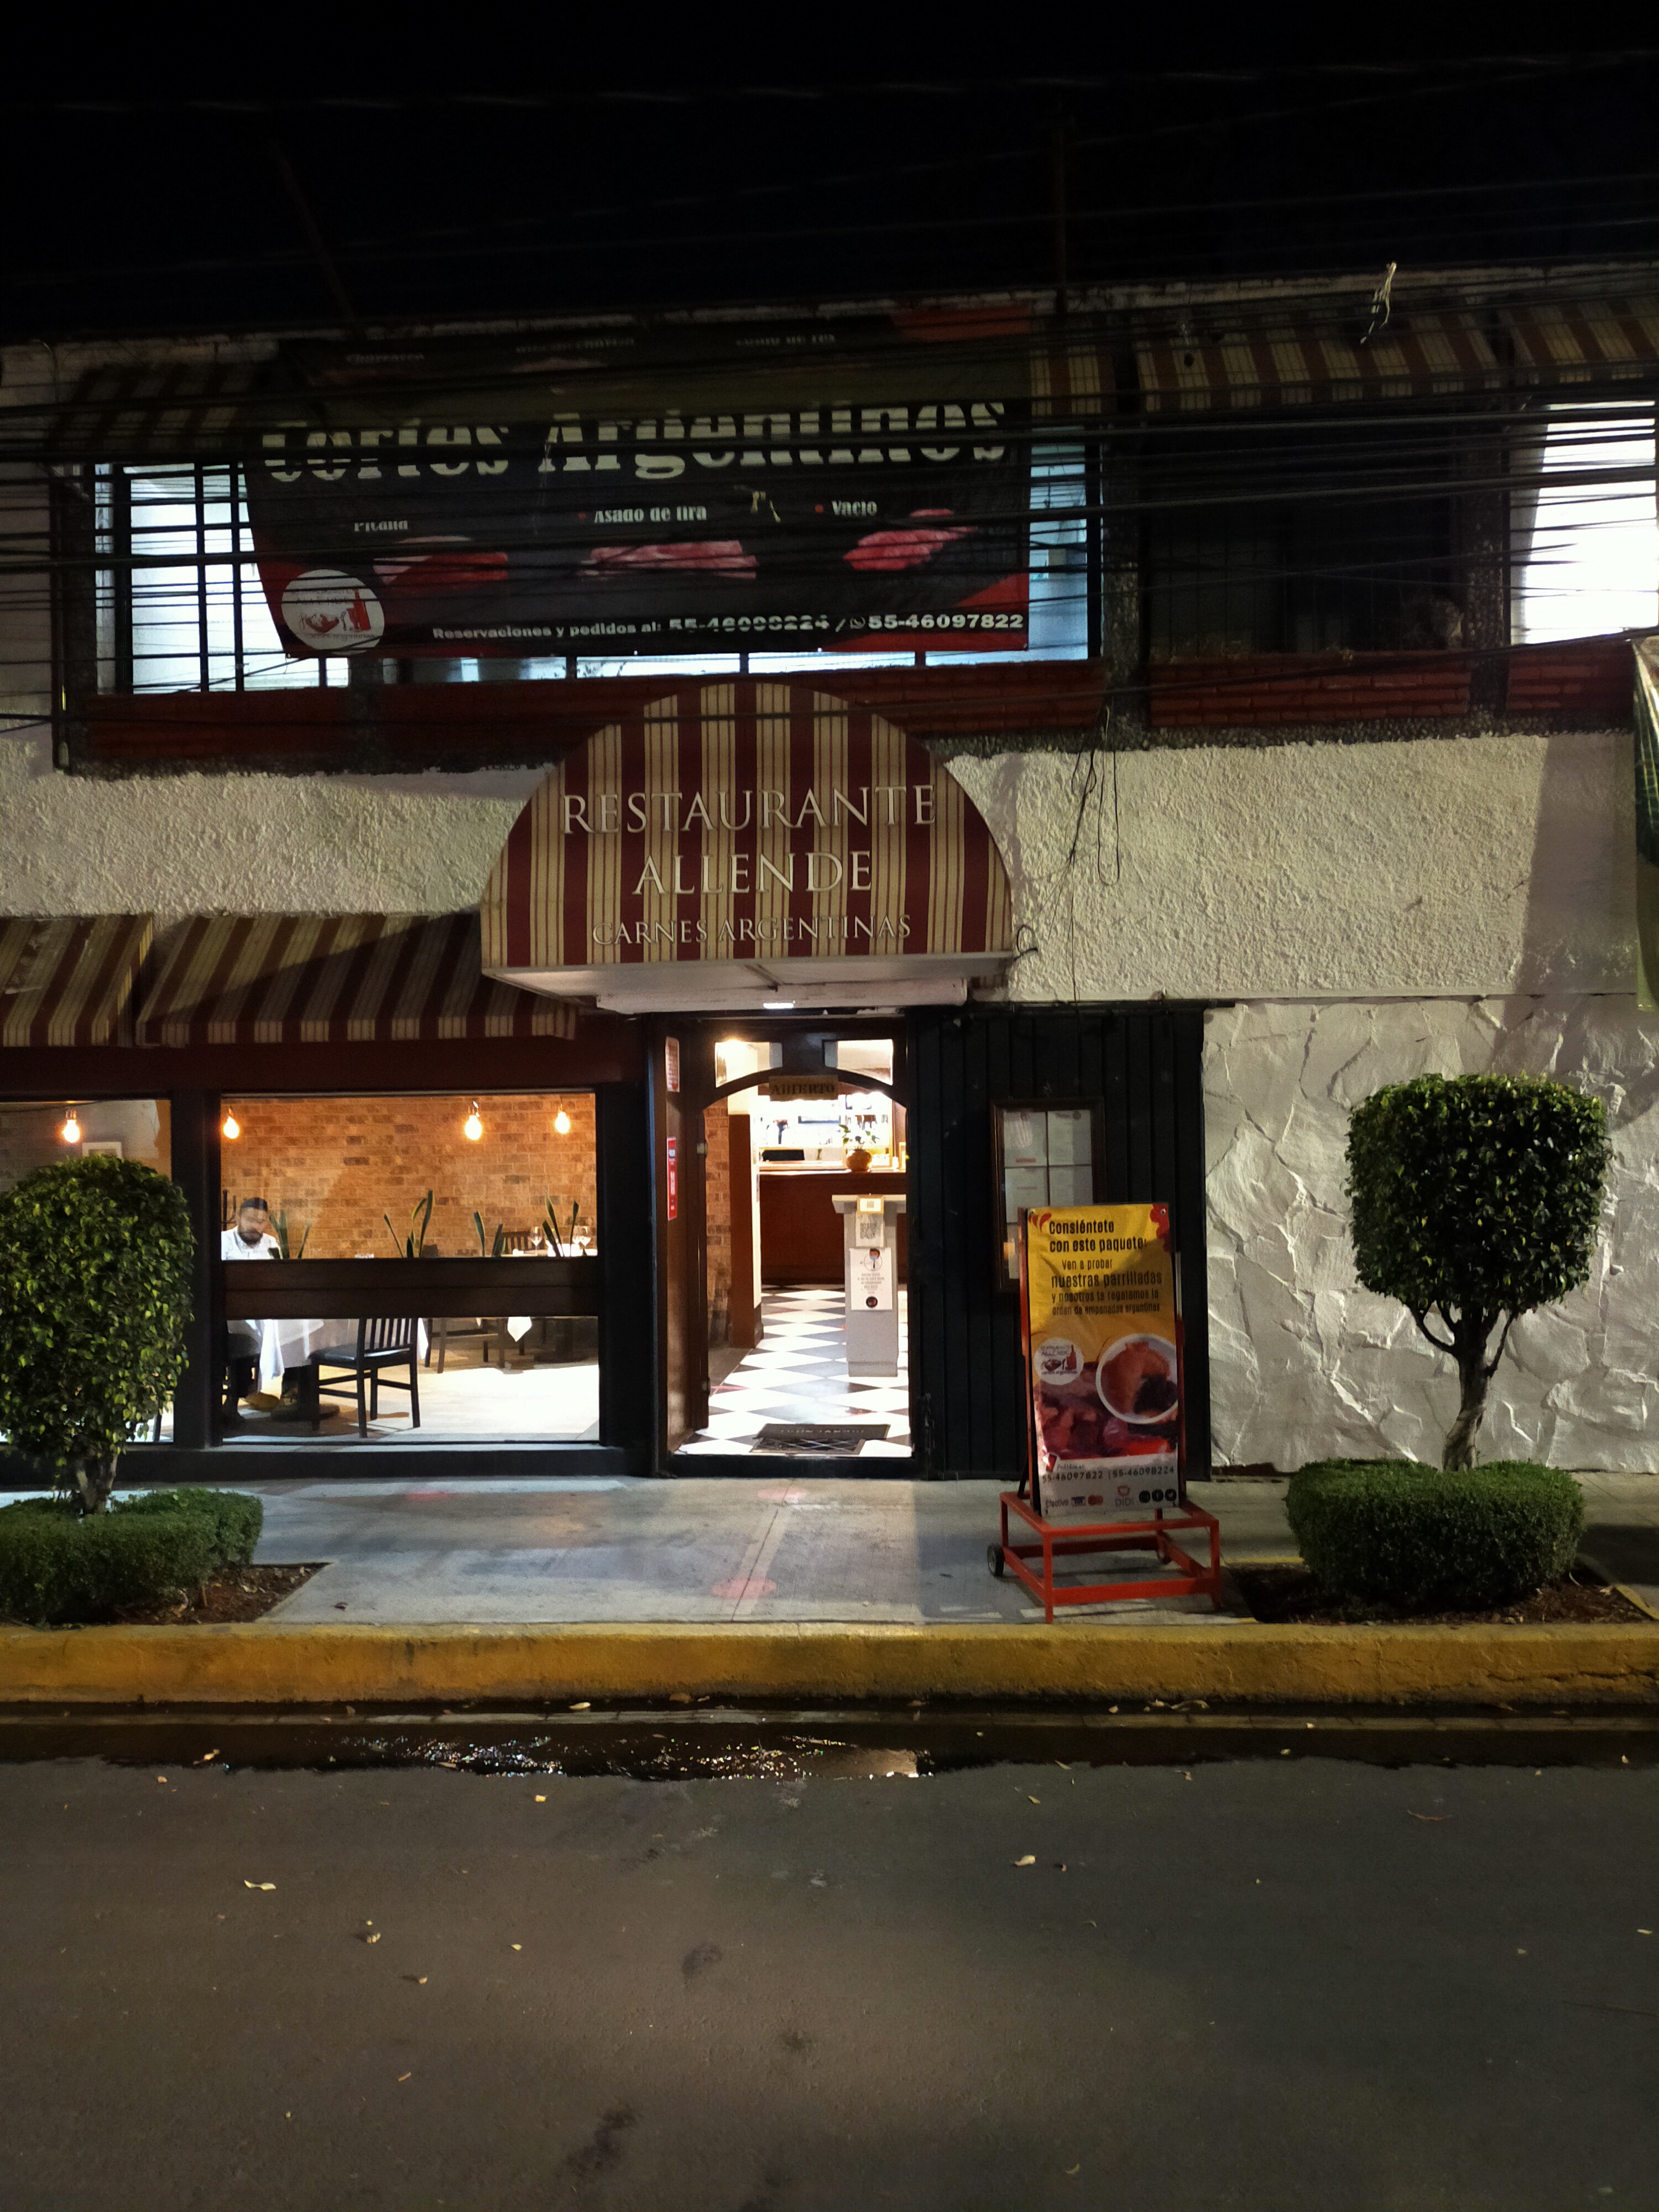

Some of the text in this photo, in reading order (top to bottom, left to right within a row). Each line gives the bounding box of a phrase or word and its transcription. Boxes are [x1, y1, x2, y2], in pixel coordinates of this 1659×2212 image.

[538, 402, 1005, 479] Argentinos
[594, 508, 644, 523] Asado
[650, 501, 671, 522] de
[433, 625, 552, 639] Reservaciones
[556, 626, 565, 638] y
[570, 622, 636, 637] pedidos
[868, 614, 1024, 629] 55-46097822
[563, 785, 935, 834] RESTAURANTE
[632, 851, 872, 895] ALLENDE
[592, 915, 911, 945] CARNES ARGENTINAS
[1050, 1219, 1114, 1234] Consiéntete
[1050, 1240, 1070, 1253] con
[1073, 1238, 1096, 1251] este
[1062, 1259, 1113, 1270] Ven a probar
[1052, 1270, 1162, 1288] nuestras parrilladas
[1052, 1292, 1056, 1303] y
[1059, 1291, 1094, 1303] nosotros
[1108, 1290, 1149, 1302] regalamos
[1052, 1302, 1160, 1316] orden de empanadas argentinas
